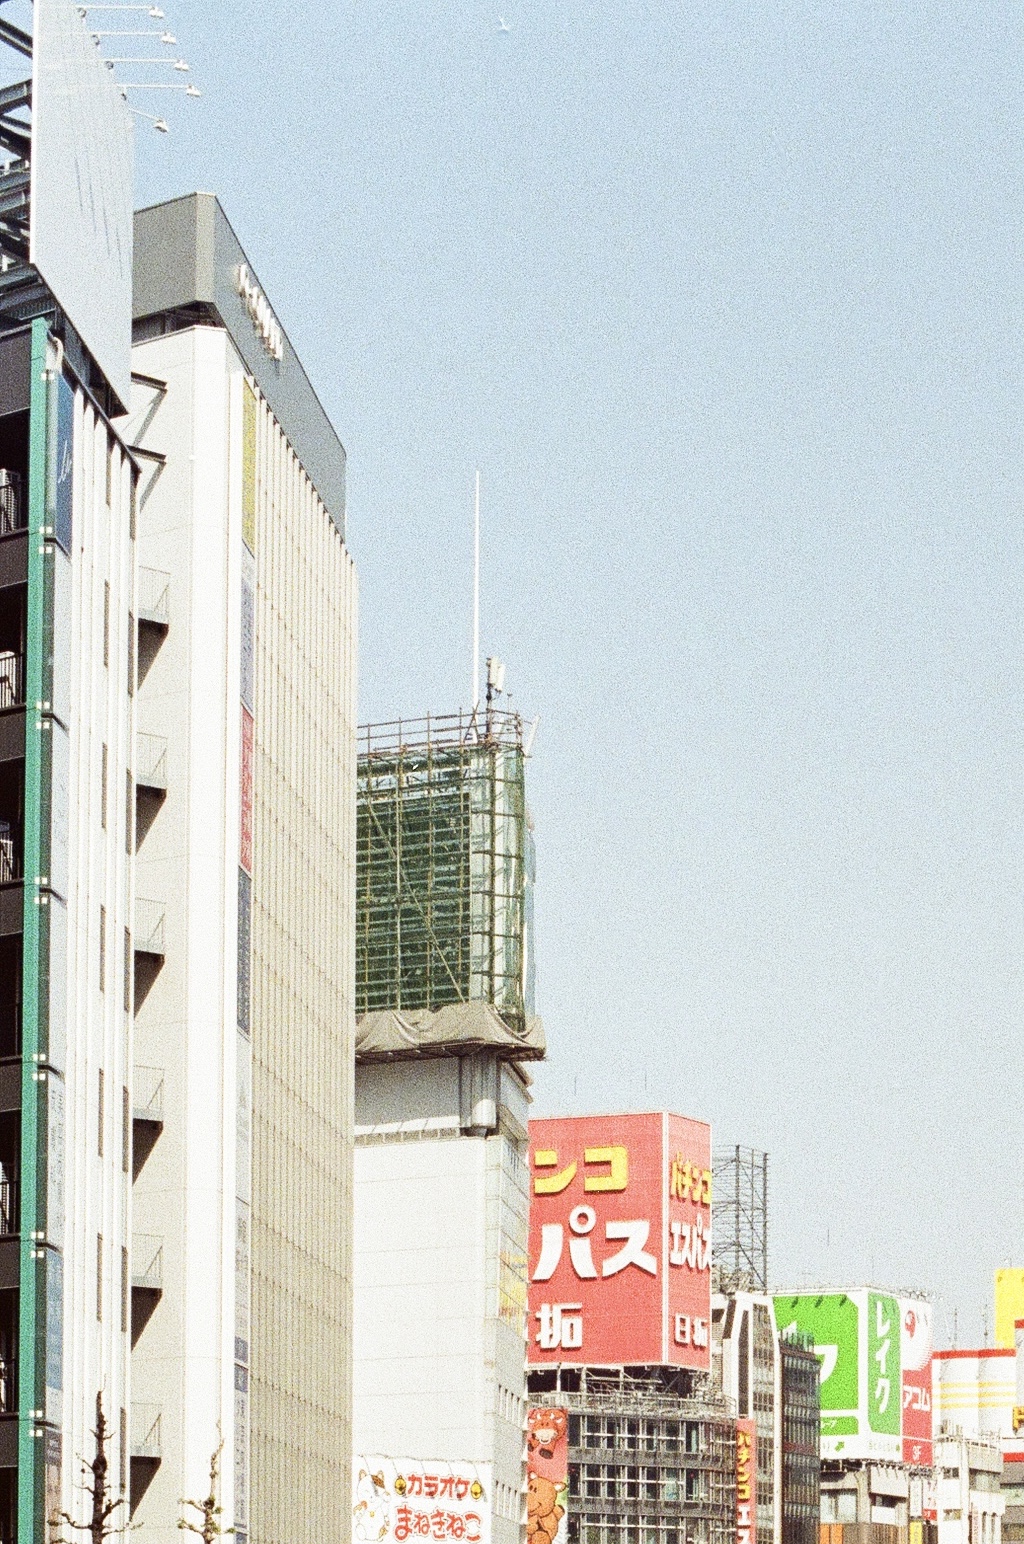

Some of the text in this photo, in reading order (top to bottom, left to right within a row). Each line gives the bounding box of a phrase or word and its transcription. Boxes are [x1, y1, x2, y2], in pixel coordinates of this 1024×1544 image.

[671, 1151, 711, 1206] パチンコ
[670, 1215, 711, 1269] エスパス
[874, 1300, 891, 1415] レイク
[902, 1384, 931, 1412] アコム
[407, 1473, 471, 1499] カラオケ
[737, 1431, 751, 1500] パチンコ
[394, 1504, 483, 1543] まねきねこ
